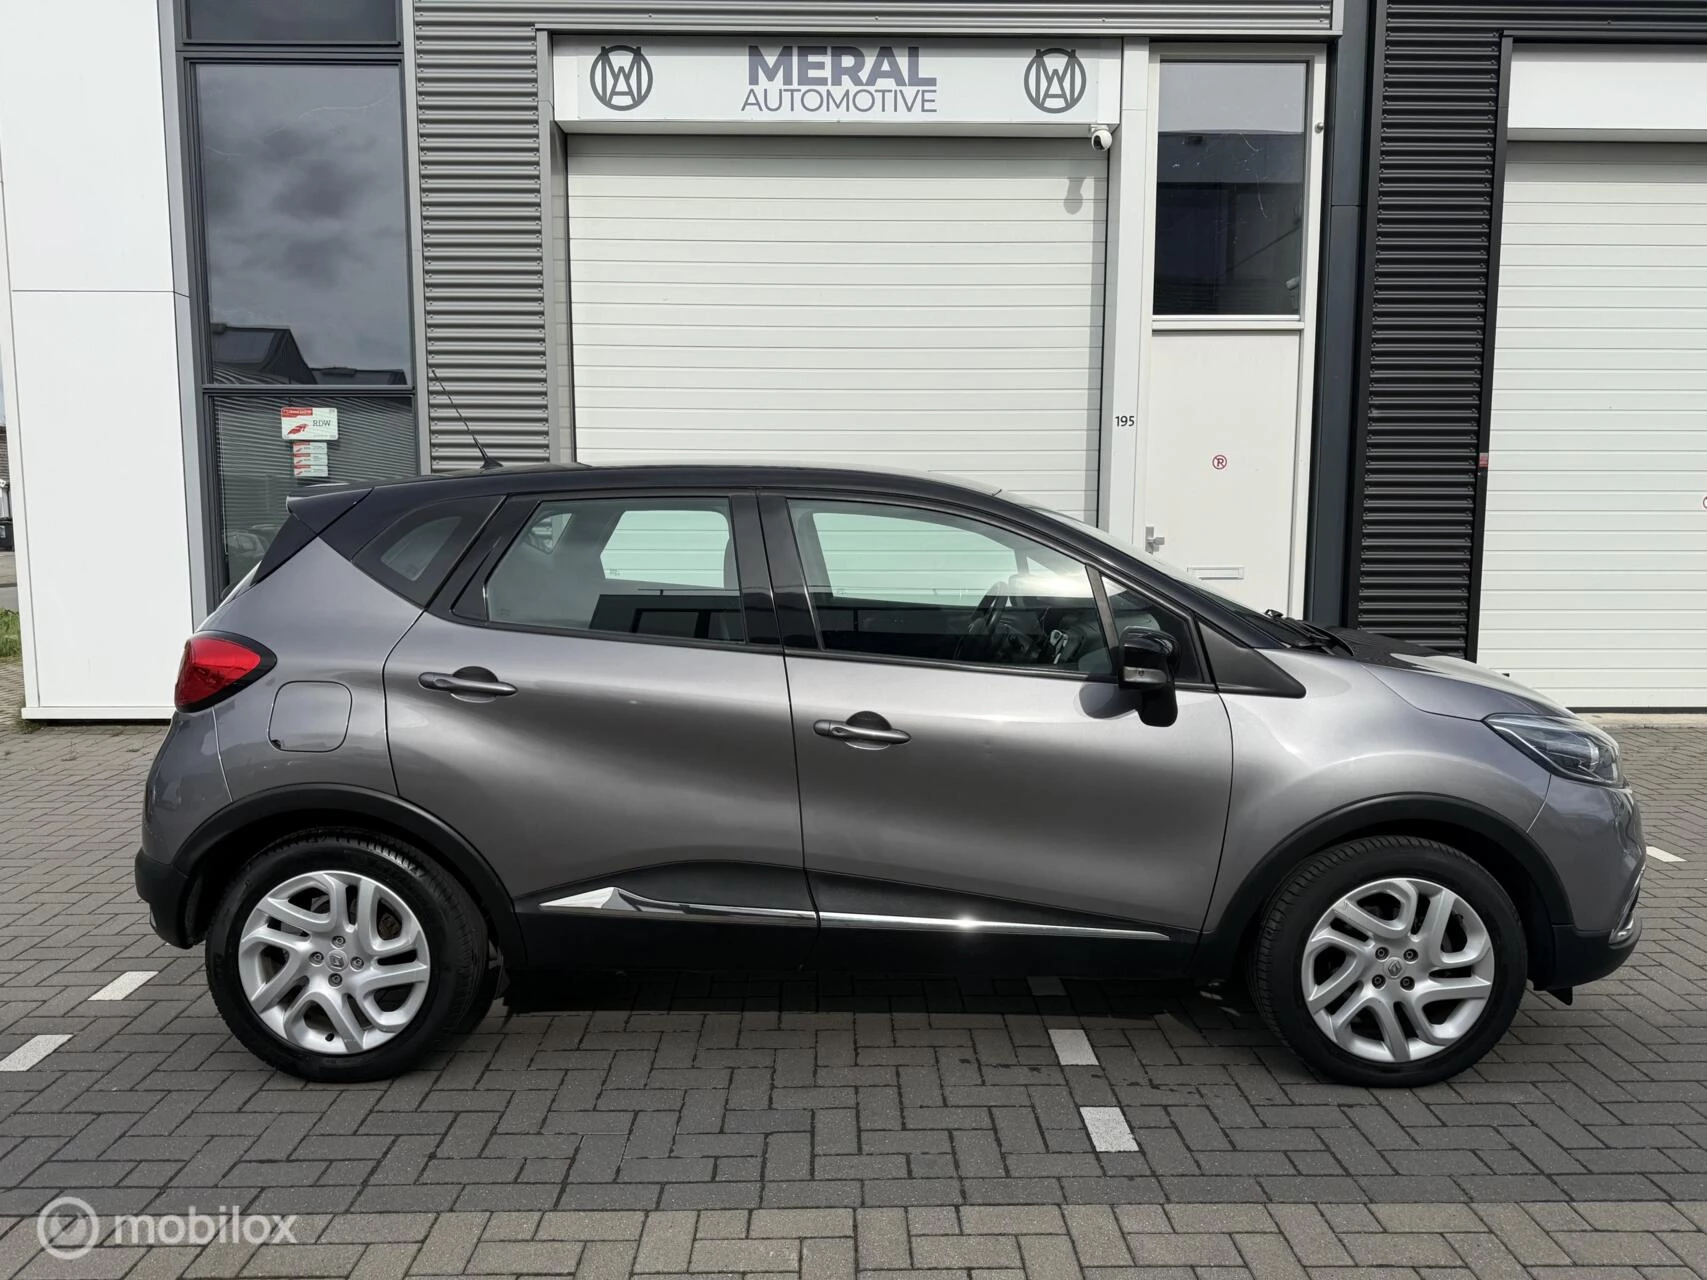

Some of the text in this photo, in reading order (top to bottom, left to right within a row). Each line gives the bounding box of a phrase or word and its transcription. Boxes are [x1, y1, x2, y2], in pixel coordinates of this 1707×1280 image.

[748, 45, 937, 87] MERAL
[741, 88, 937, 113] AUTOMOTIVE
[1115, 415, 1135, 427] 195
